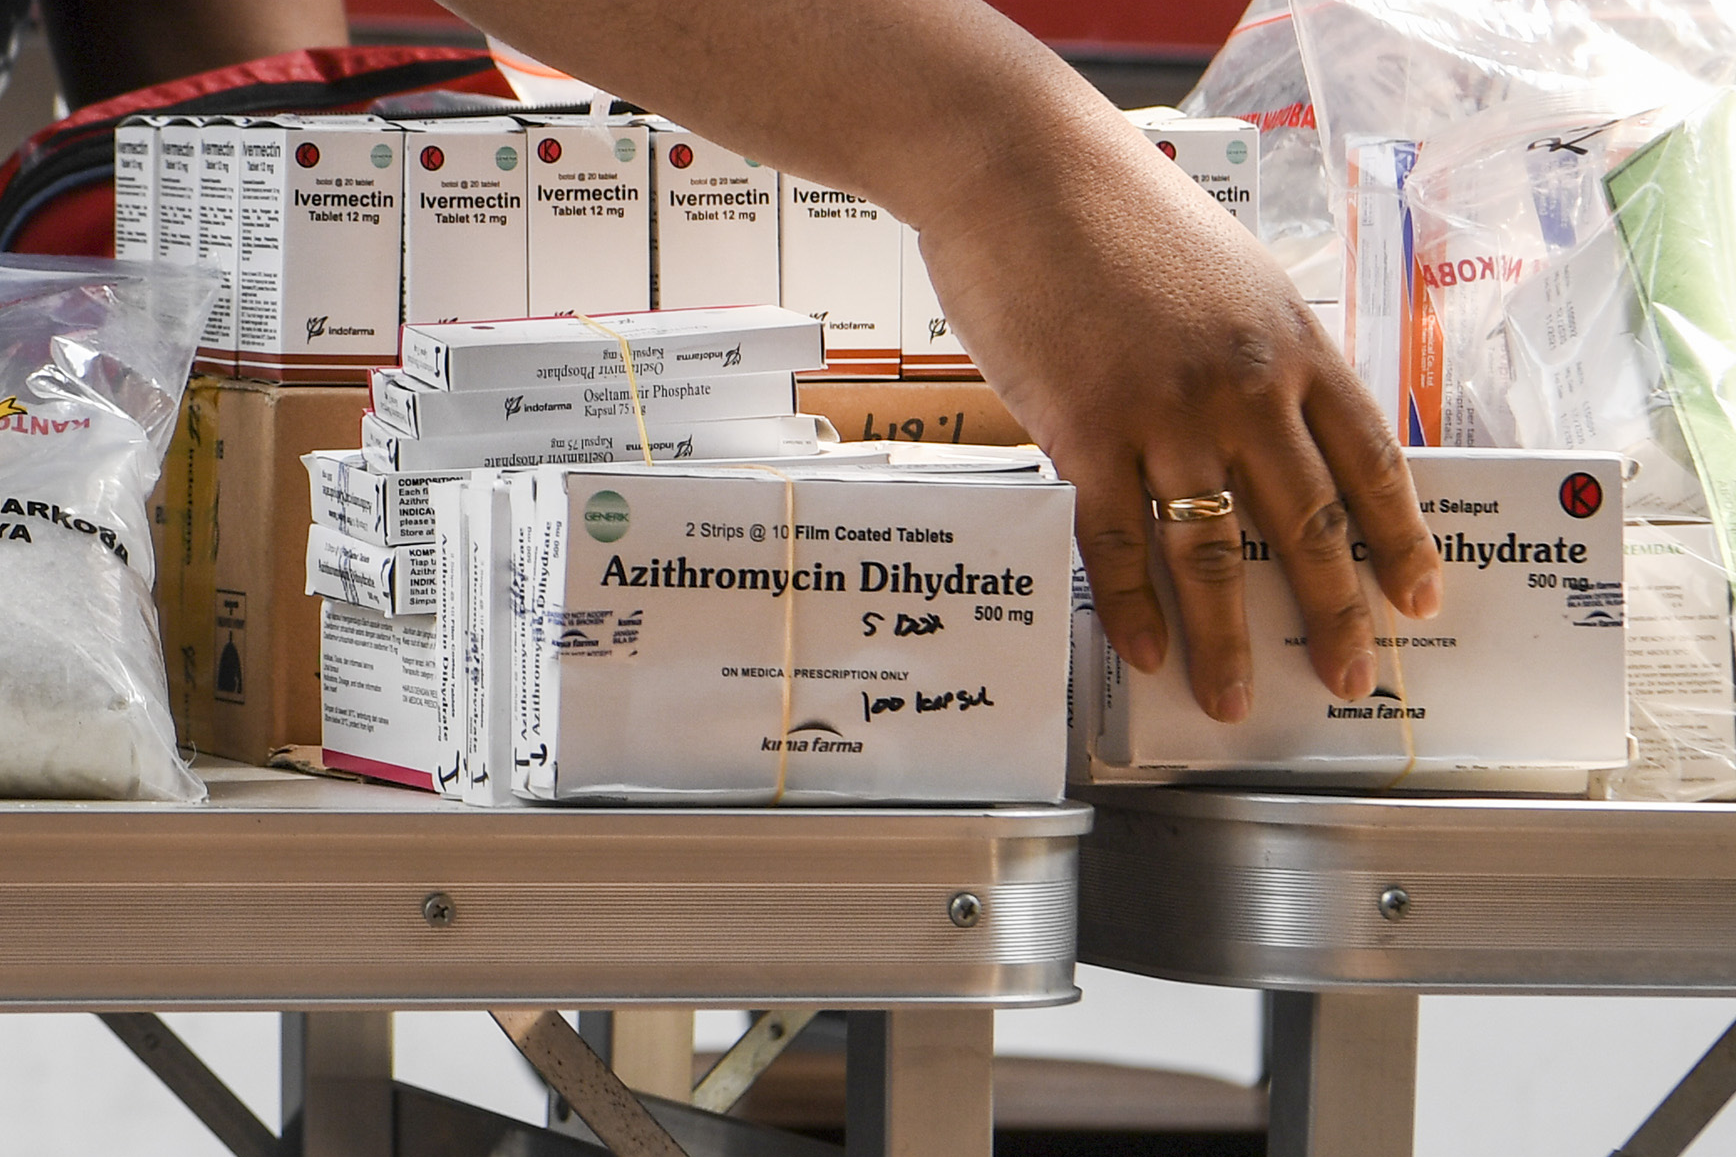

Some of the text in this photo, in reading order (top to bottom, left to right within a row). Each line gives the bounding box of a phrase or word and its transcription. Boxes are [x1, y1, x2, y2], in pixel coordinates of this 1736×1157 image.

[242, 141, 281, 158] Ivermectin
[294, 189, 394, 208] Ivermectin
[420, 192, 521, 209] Ivermectin
[538, 185, 638, 201] Ivermectin
[670, 189, 769, 206] Ivermectin
[793, 187, 868, 204] Iverme
[1207, 186, 1250, 203] ectin
[309, 210, 380, 225] Tablet 12 mg
[435, 213, 507, 226] Tablet 12 mg
[552, 206, 624, 218] Tablet 12 mg
[685, 210, 756, 222] Tablet 12 mg
[808, 208, 878, 220] Tablet 12 mg
[328, 326, 375, 336] indofarma
[829, 322, 875, 331] indofarma
[1426, 314, 1437, 355] Chemical
[602, 349, 618, 361] mg
[676, 350, 724, 362] indofarma
[536, 361, 665, 381] Oseltmivir Phosphate
[653, 382, 711, 401] Phosphate
[523, 402, 572, 413] indofarma
[584, 402, 630, 418] Kapsul 75
[550, 436, 614, 451] Kapsul 75 mg
[398, 488, 421, 497] Each
[1439, 499, 1499, 515] Selaput
[399, 518, 429, 528] please
[584, 511, 629, 523] GENERIK
[400, 528, 424, 538] Store
[686, 522, 954, 544] 2 Strips @ 10 Film Coated Tablets
[552, 540, 561, 559] 500
[410, 559, 429, 568] Tiap
[534, 521, 552, 609] Dihydrate
[600, 553, 1034, 601] Azithromycin Dihydrate
[1527, 573, 1558, 589] 500
[974, 605, 1034, 626] 500 mg
[1284, 637, 1308, 647] HAR
[1411, 637, 1457, 648] DOKTER
[721, 667, 910, 682] ON MEDICA PRESCRIPTION ONLY
[442, 656, 450, 742] Dihydrate
[1327, 703, 1374, 720] kimia
[811, 736, 863, 755] farma
